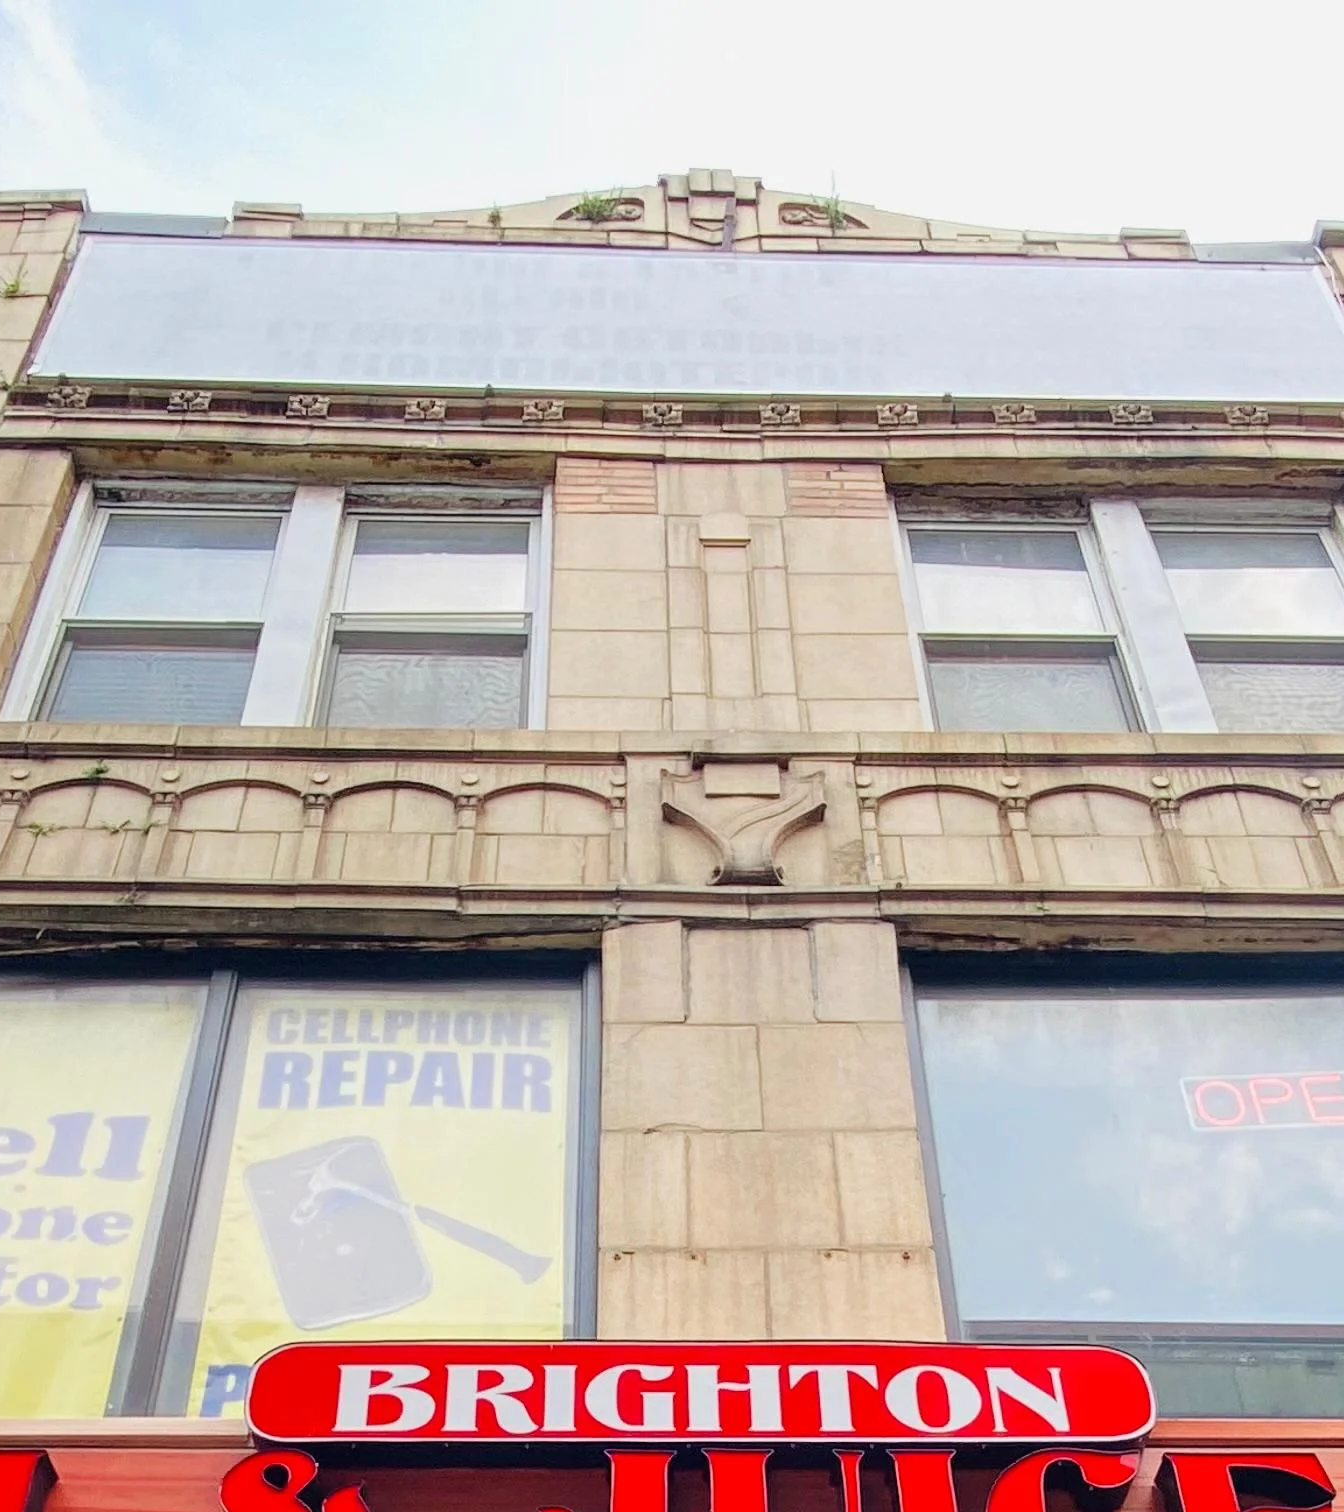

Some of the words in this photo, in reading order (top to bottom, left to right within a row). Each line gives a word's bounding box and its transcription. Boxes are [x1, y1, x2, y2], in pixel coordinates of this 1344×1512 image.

[265, 1007, 553, 1048] CELLPHONE
[257, 1050, 553, 1113] REPAIR
[331, 1363, 1073, 1434] BRIGHTON
